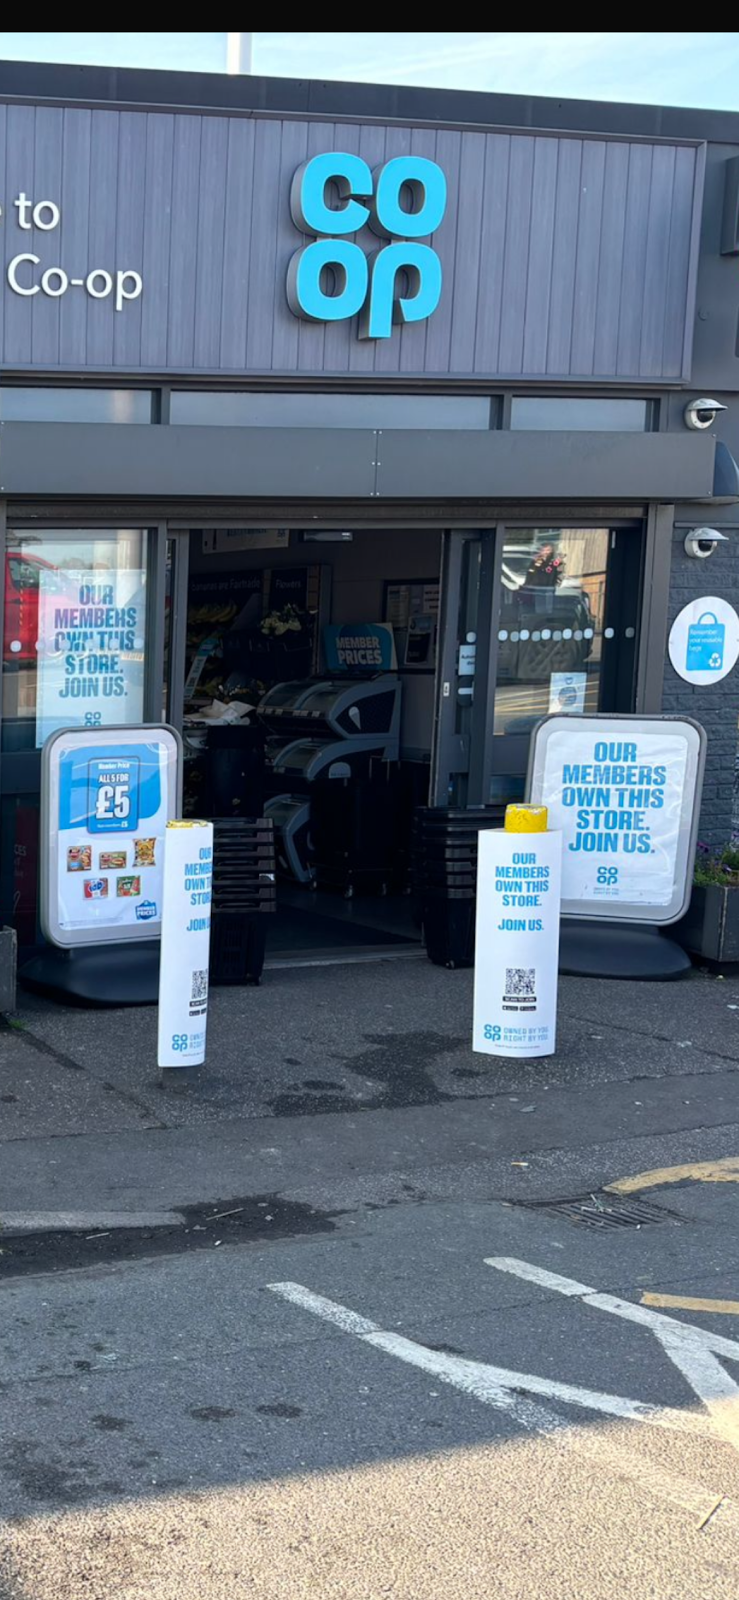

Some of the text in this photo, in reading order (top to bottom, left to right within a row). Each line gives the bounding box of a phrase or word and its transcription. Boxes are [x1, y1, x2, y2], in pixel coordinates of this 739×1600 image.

[14, 192, 60, 230] to
[7, 253, 143, 312] Co-op
[275, 579, 302, 589] Flowers
[79, 585, 113, 606] OUR
[54, 607, 137, 629] MEMBERS
[335, 636, 380, 649] MEMBER
[65, 654, 124, 675] STORE.
[337, 649, 383, 665] PRICES
[58, 676, 128, 698] JOIN US.
[594, 742, 637, 762] OUR
[98, 773, 129, 783] ALL 5 FOR
[562, 764, 667, 786] MEMBERS
[95, 785, 130, 819] £5
[562, 787, 664, 808] OWN THIS
[576, 809, 650, 830] STORE.
[568, 832, 655, 853] JOIN US.
[512, 852, 536, 864] OUR
[495, 866, 550, 879] MEMBERS
[184, 877, 205, 891] OWN
[495, 880, 549, 893] OWN THIS
[502, 894, 542, 907] STORE.
[186, 918, 206, 932] JOIN
[497, 919, 544, 932] JOIN US.
[503, 1027, 527, 1035] OWNED
[503, 1033, 548, 1042] RIGHT BY YOU
